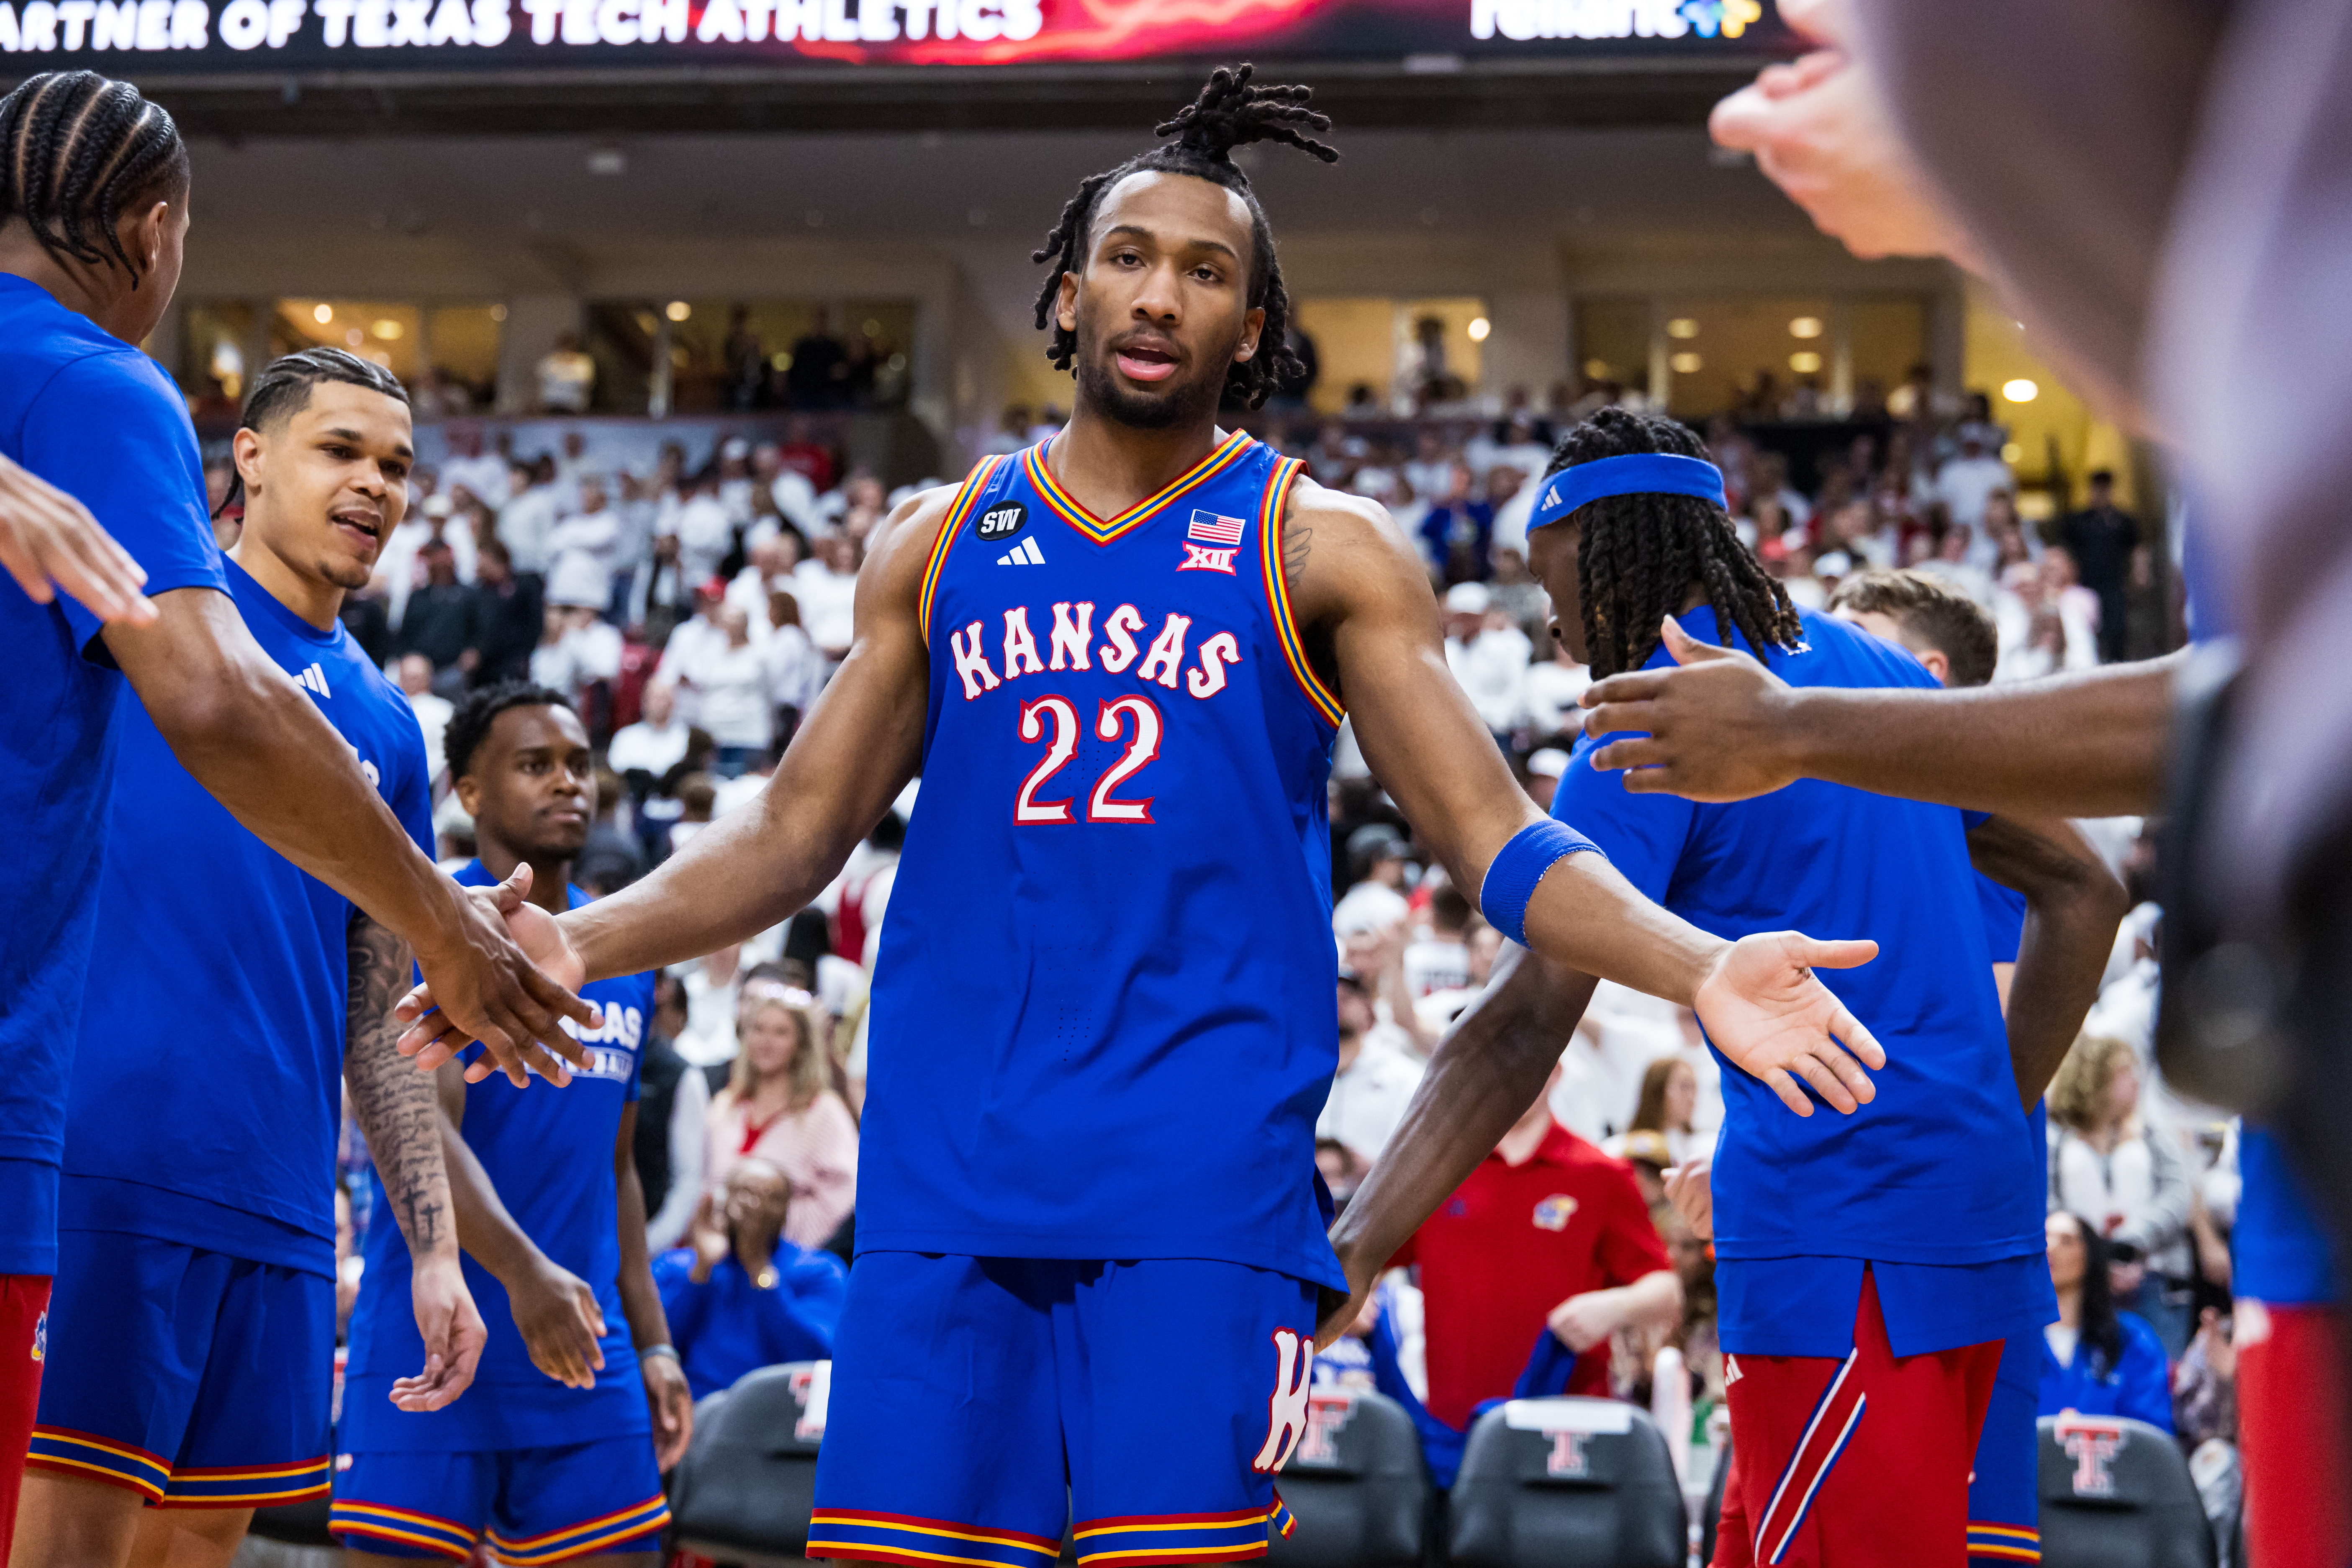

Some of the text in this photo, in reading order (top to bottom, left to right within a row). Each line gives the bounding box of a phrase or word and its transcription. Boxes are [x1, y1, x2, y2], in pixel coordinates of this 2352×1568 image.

[219, 0, 307, 49] OF
[314, 0, 511, 47] TEXAS
[521, 0, 689, 45] TECH
[696, 0, 1042, 42] ATHLETICS
[981, 508, 1022, 534] SW
[950, 601, 1243, 701] KANSAS
[1013, 694, 1164, 826] 22
